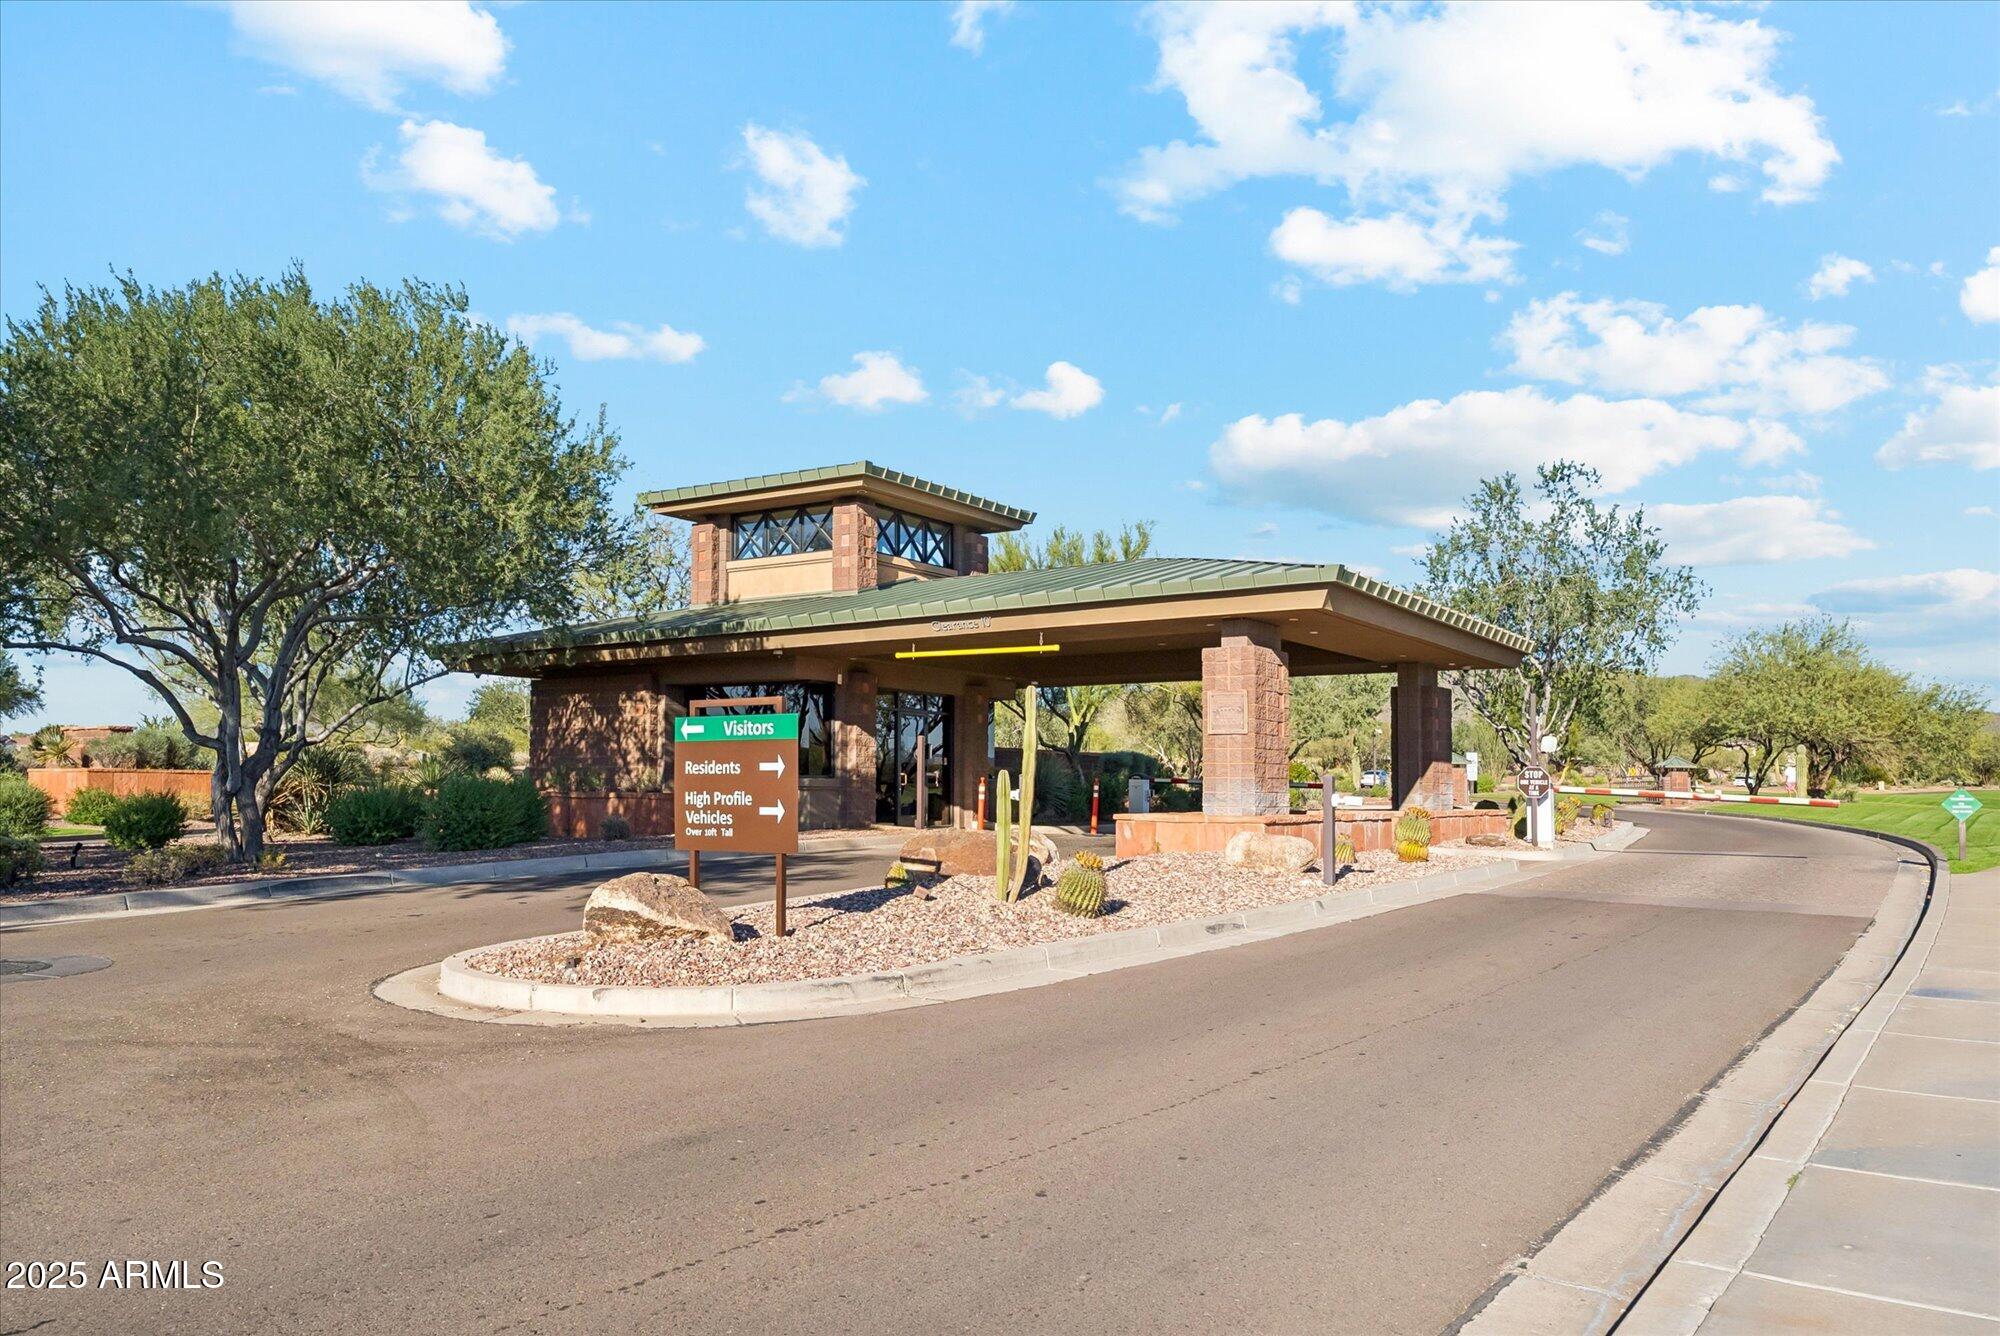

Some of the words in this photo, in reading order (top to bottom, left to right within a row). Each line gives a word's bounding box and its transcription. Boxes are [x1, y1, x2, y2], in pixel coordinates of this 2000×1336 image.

[931, 620, 979, 632] Clearance
[723, 720, 774, 736] Visitors
[685, 760, 741, 775] Residents
[1524, 770, 1544, 779] STOP
[685, 791, 711, 808] High
[713, 791, 753, 806] Profile
[685, 810, 733, 825] Vehicles
[685, 827, 702, 836] Over
[704, 827, 718, 837] 10ft
[720, 827, 734, 837] Tall
